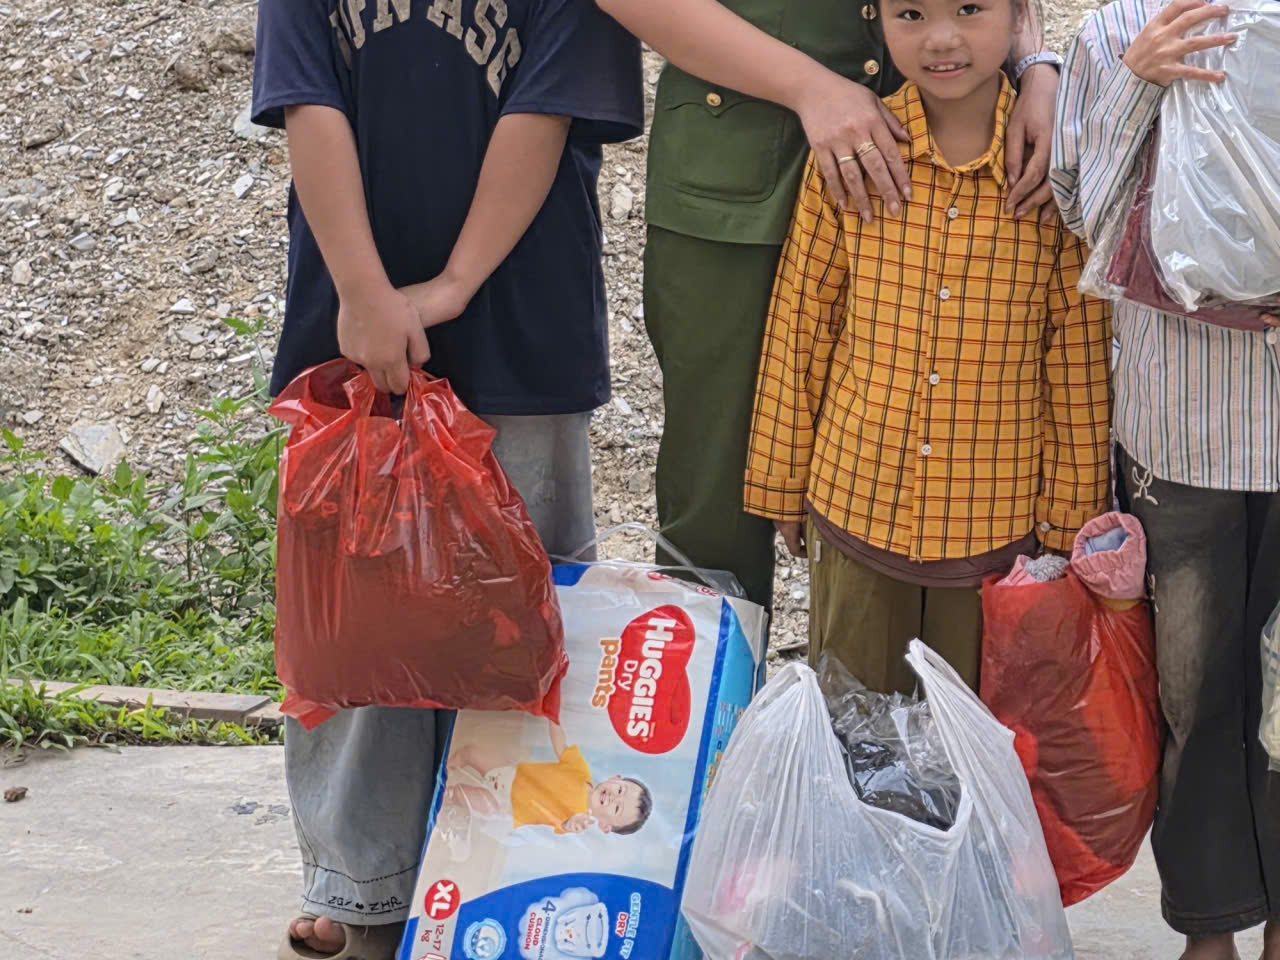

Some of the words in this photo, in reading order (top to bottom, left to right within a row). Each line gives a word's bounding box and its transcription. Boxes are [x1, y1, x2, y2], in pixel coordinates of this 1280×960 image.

[591, 638, 621, 708] pants
[618, 660, 639, 691] Dry
[626, 617, 677, 737] HUGGIES
[430, 882, 454, 917] XL
[626, 892, 641, 938] GENTLE
[421, 929, 433, 942] kg
[433, 924, 445, 951] 12-17
[524, 912, 536, 950] CUSHION
[532, 917, 543, 946] CLOUD
[615, 912, 628, 937] DRY
[620, 939, 634, 959] FIT
